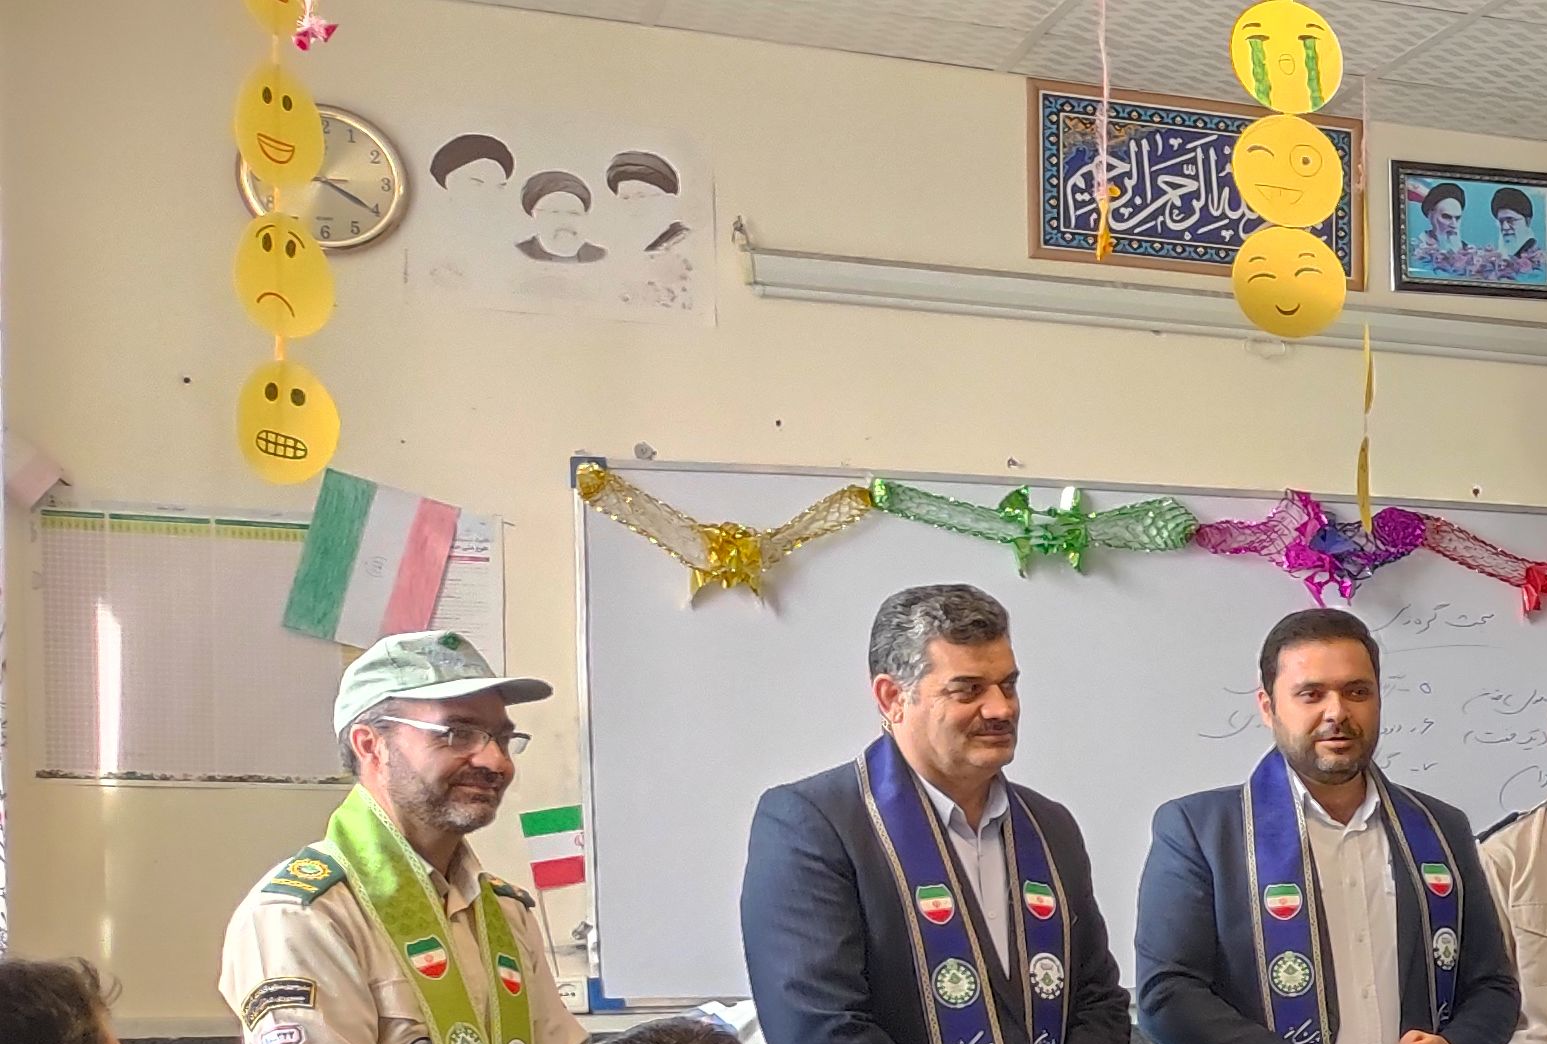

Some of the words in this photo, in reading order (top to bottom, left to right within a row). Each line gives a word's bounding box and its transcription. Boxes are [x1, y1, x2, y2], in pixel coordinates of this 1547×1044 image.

[347, 129, 356, 143] 1
[370, 150, 381, 164] 2
[381, 178, 392, 191] 3
[372, 203, 381, 217] 4
[320, 225, 331, 239] 6
[350, 221, 361, 235] 5
